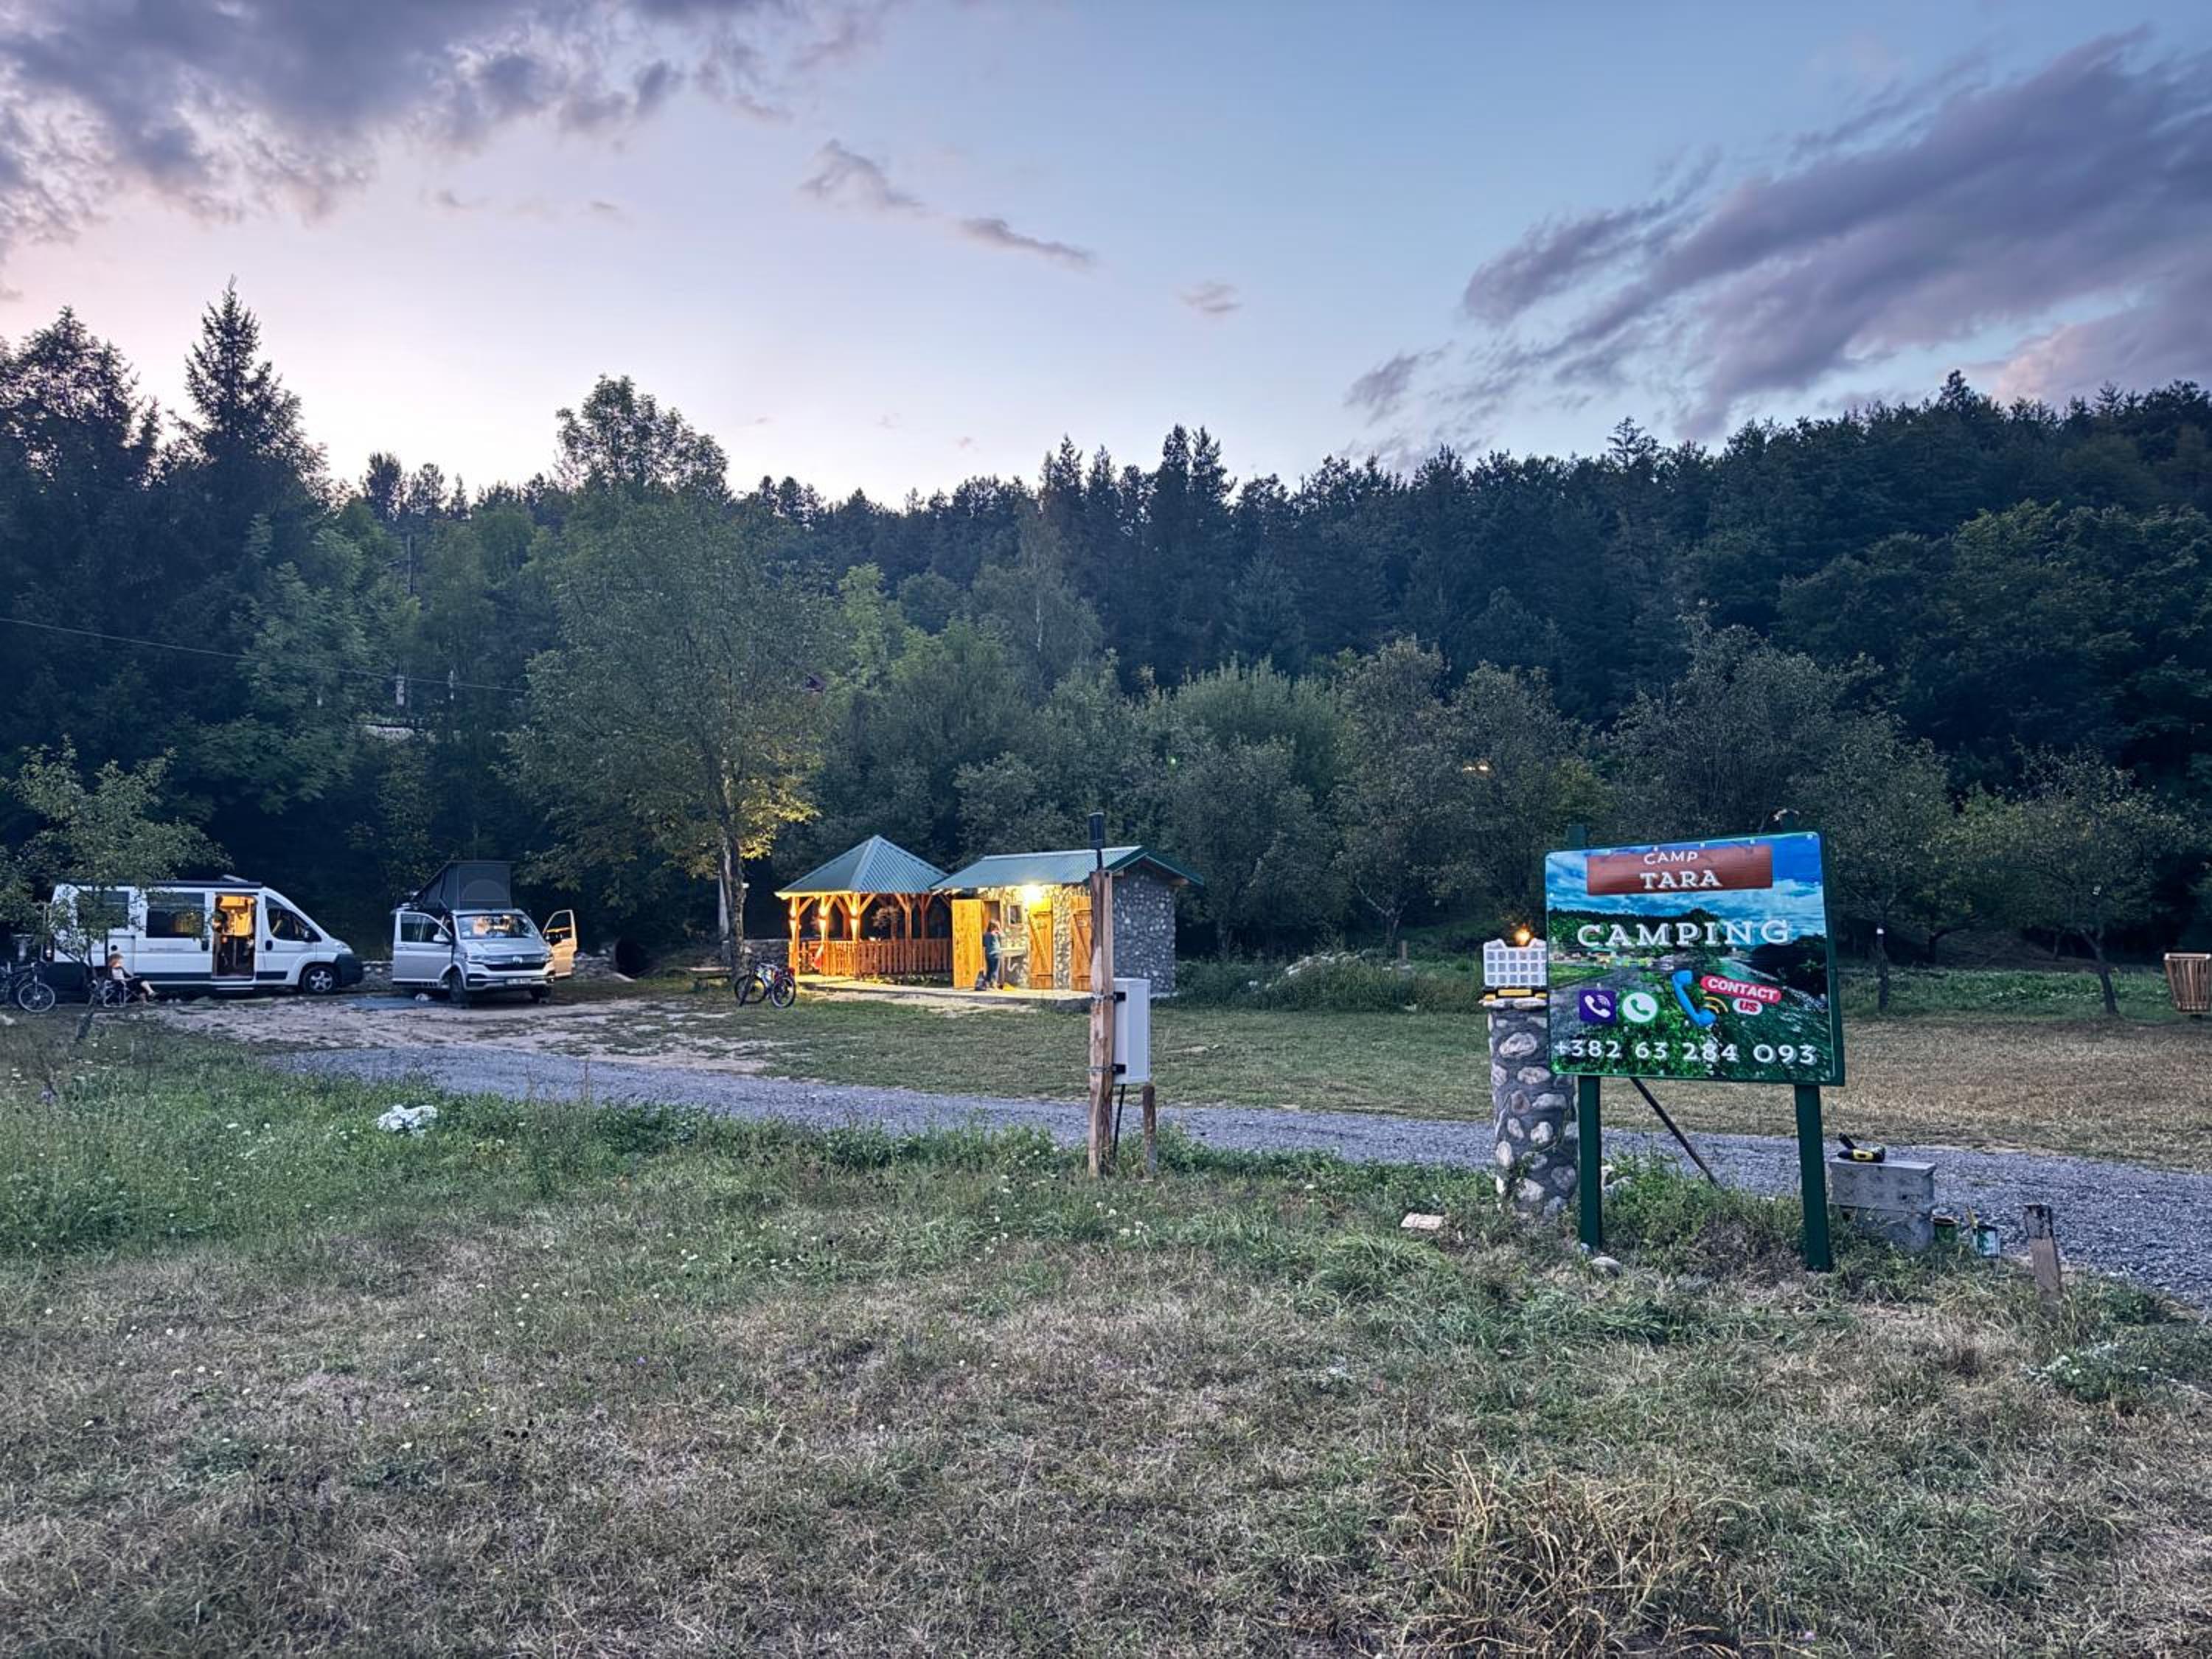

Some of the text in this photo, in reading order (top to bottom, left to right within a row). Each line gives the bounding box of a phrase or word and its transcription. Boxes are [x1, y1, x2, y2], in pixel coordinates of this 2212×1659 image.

[1644, 851, 1698, 865] CAMP
[1640, 869, 1722, 889] TARA
[1577, 919, 1791, 947] CAMPING
[1708, 978, 1778, 1000] CONTACT
[1739, 1001, 1759, 1012] US
[1554, 1040, 1816, 1063] +382 63 284 093
